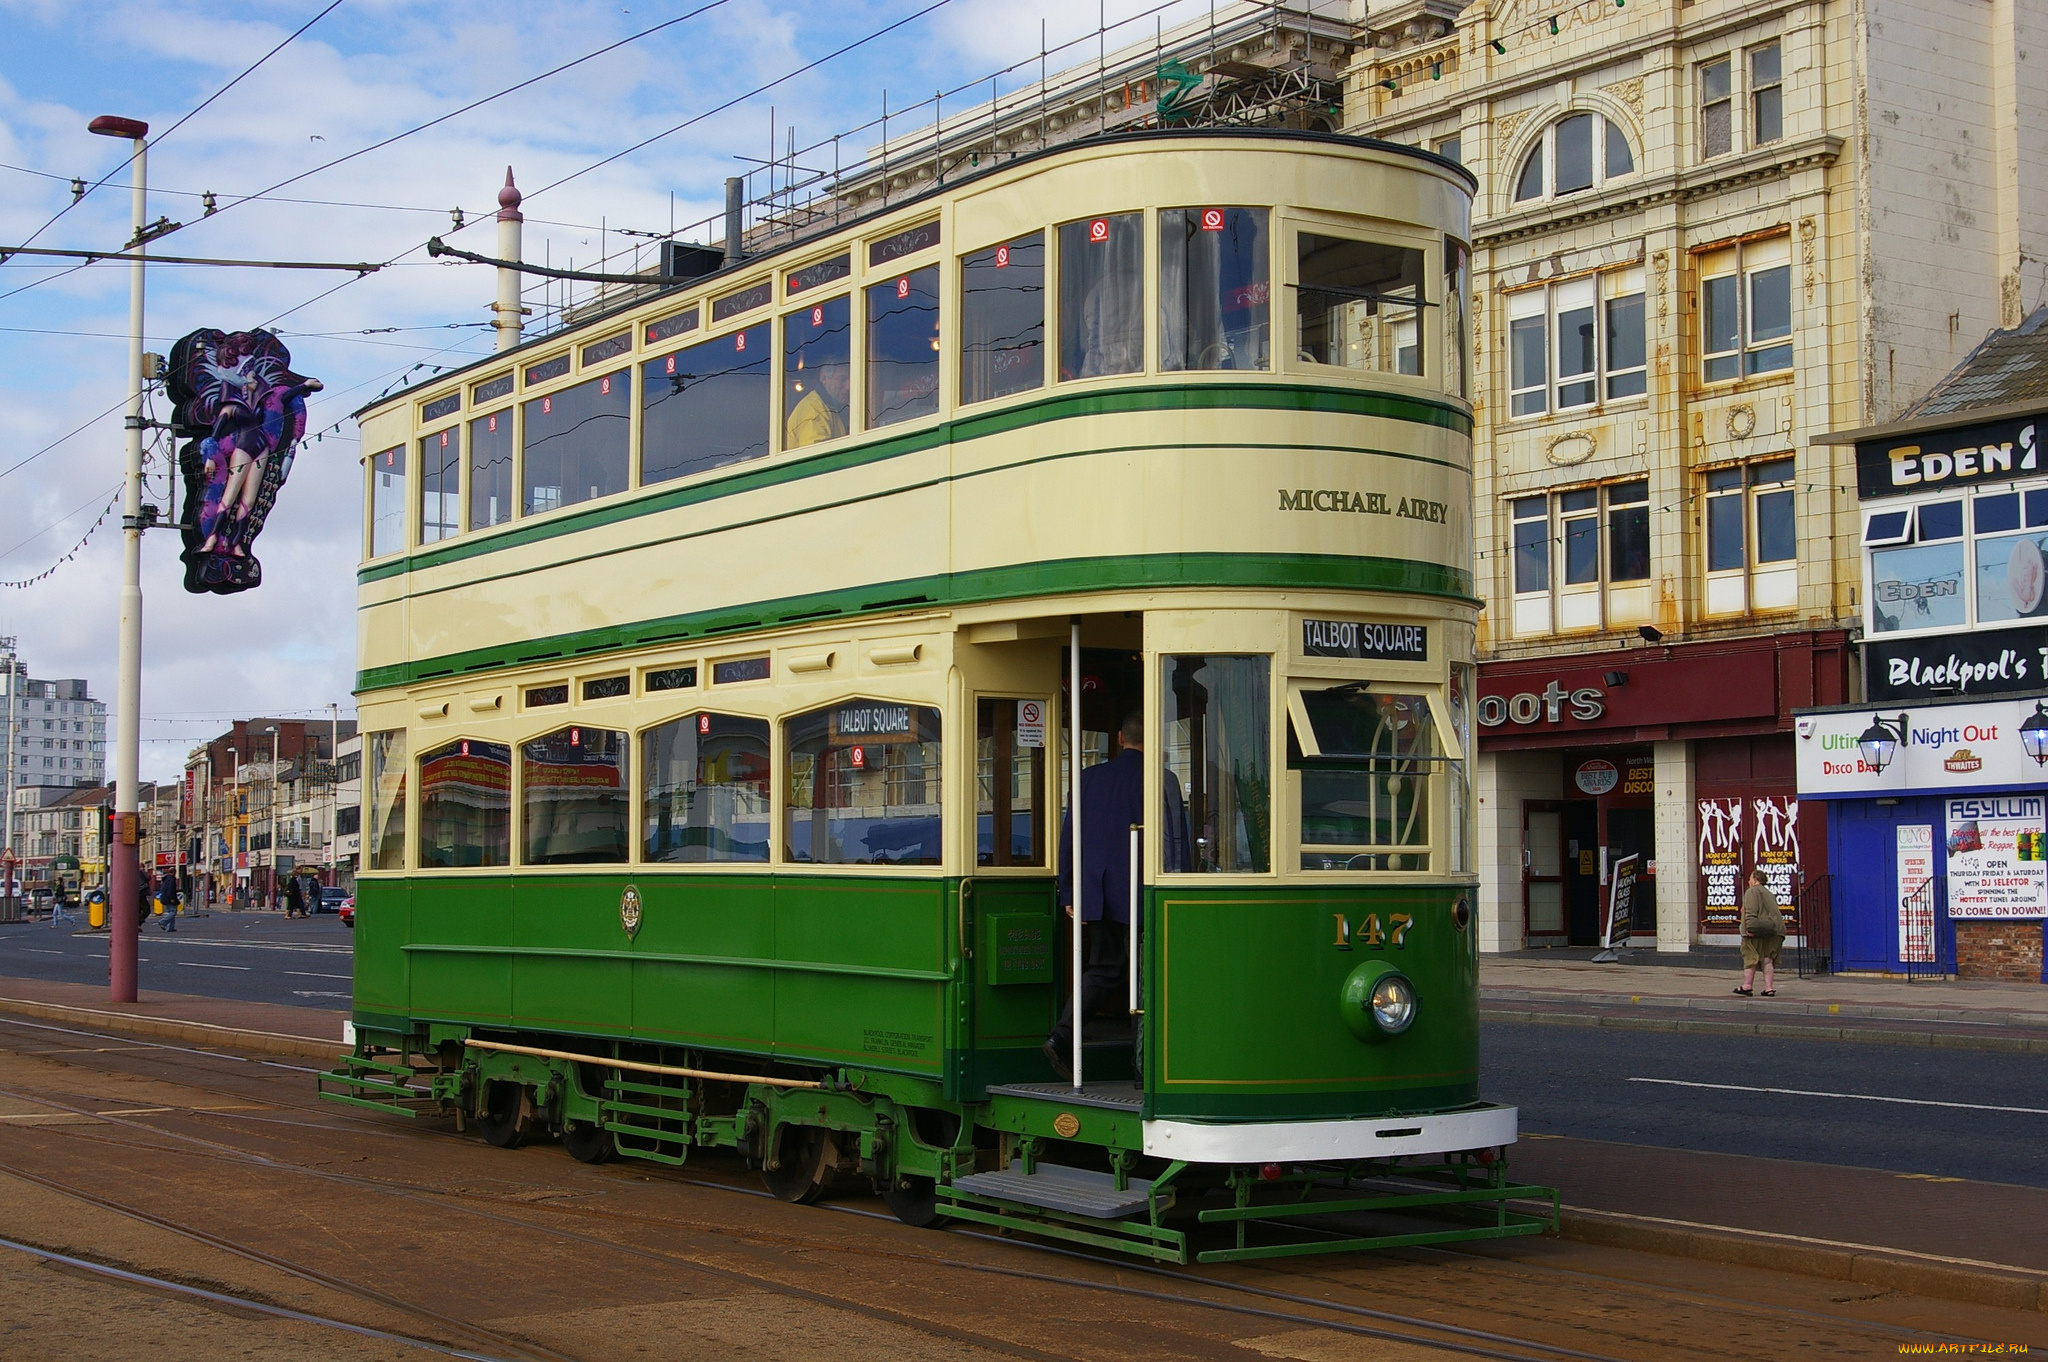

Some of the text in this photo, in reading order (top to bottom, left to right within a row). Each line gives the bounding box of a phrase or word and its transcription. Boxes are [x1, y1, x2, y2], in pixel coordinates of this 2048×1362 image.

[1278, 489, 1448, 524] MICHAEL AIREY
[1877, 580, 1957, 602] EDEN
[1304, 620, 1423, 653] TALBOT SQUARE
[1888, 649, 2027, 691] Blackpool's
[840, 707, 909, 733] TALBOT SQUARE
[1912, 727, 1959, 749] Night
[1963, 725, 1998, 742] Out
[1946, 760, 1980, 771] THWAITES
[1598, 771, 1613, 779] PUB
[1628, 768, 1654, 780] BEST
[1582, 779, 1612, 787] AWARDS
[1950, 798, 2041, 819] ASYLUM
[1979, 829, 1988, 837] all
[1990, 827, 2001, 837] the
[2002, 827, 2019, 837] best
[1988, 840, 2015, 852] Reggae,
[1701, 864, 1740, 876] NAUGHTY
[1987, 860, 2008, 869] OPEN
[1708, 875, 1734, 886] GLASS
[1981, 879, 1991, 887] DJ
[1994, 878, 2029, 886] SELECTOR
[1707, 885, 1736, 896] DANCE
[1707, 895, 1736, 906] FLOOR!
[1949, 906, 2046, 916] SO COME ON DOWN!!
[1333, 913, 1414, 951] 147
